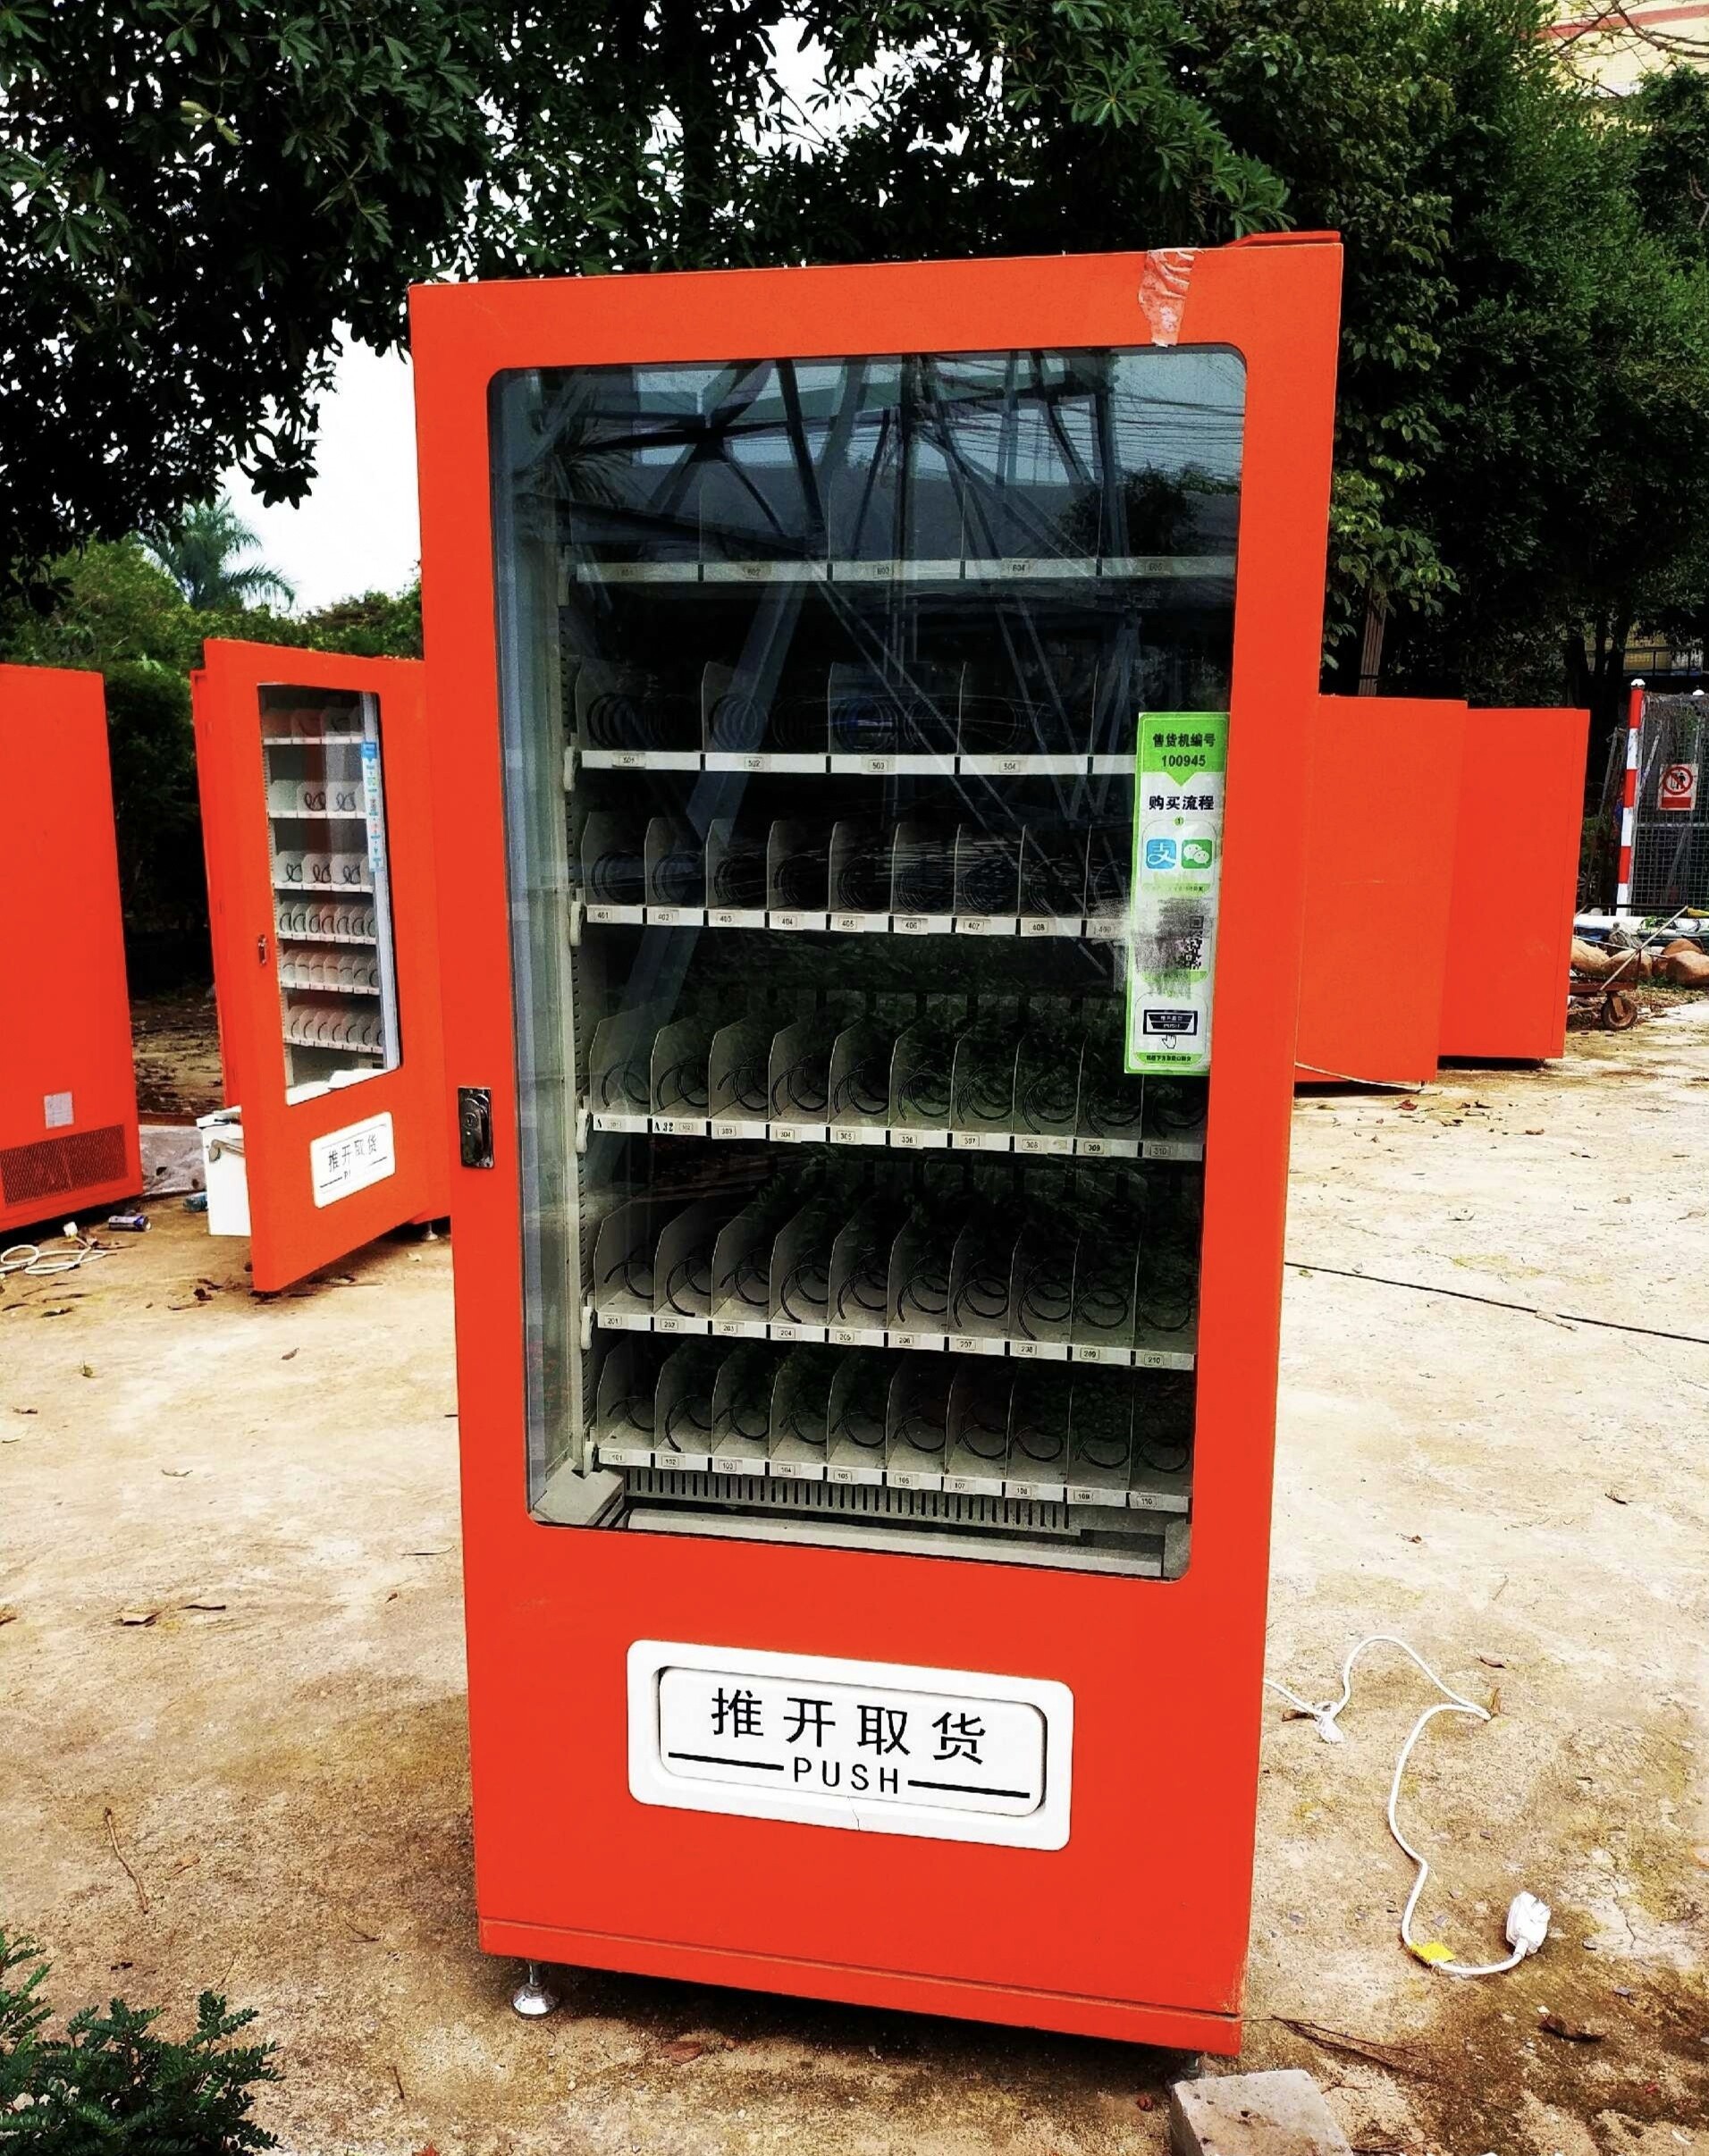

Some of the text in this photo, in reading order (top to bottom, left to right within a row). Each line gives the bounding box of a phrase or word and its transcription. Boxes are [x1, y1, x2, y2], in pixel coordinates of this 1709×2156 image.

[1152, 733, 1216, 748] 售货机编号
[1161, 754, 1207, 768] 100945
[1149, 795, 1215, 811] 购买流程
[711, 1687, 987, 1765] 推开取货
[793, 1756, 899, 1795] PUSH
